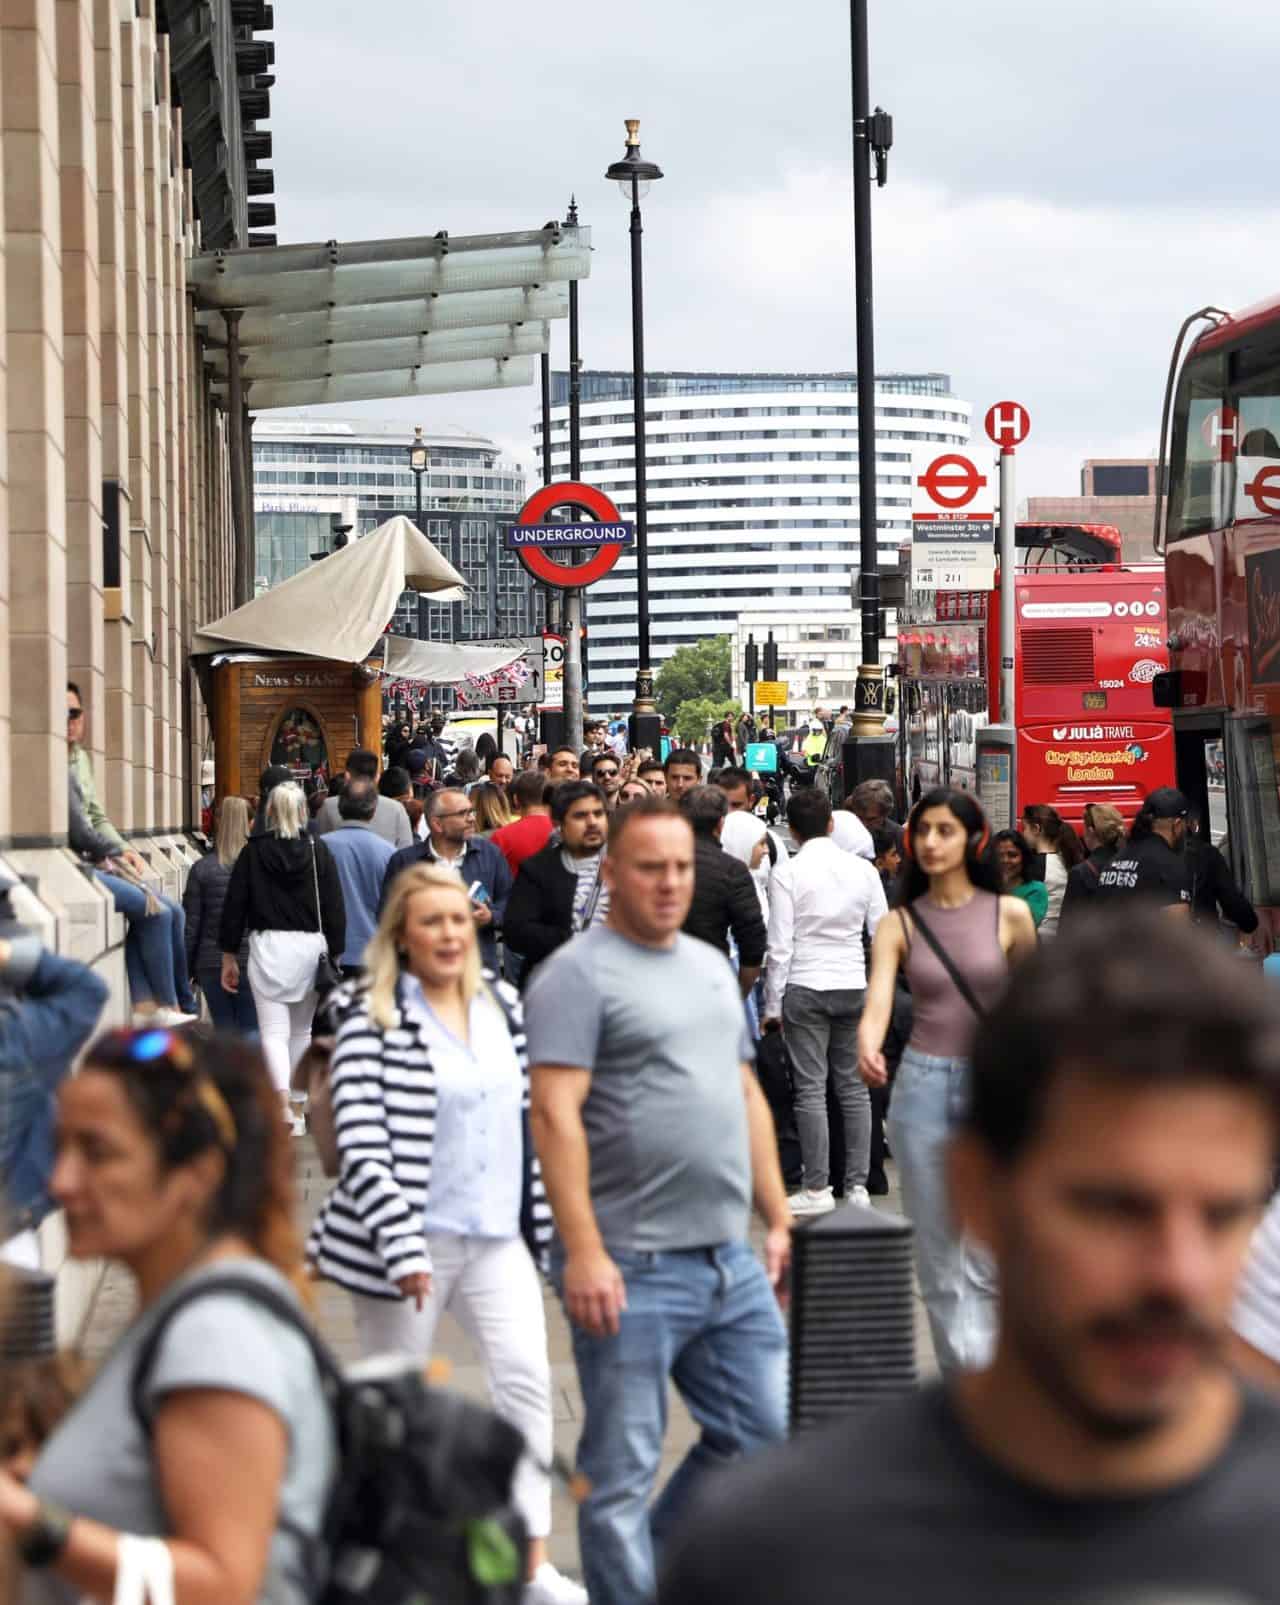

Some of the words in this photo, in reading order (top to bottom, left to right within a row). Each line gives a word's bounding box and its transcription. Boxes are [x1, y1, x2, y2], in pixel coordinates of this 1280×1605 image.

[993, 407, 1021, 440] H
[513, 527, 626, 542] UNDERGROUND
[945, 573, 961, 583] 211
[1103, 726, 1136, 739] TRAVEL
[1066, 766, 1115, 781] London
